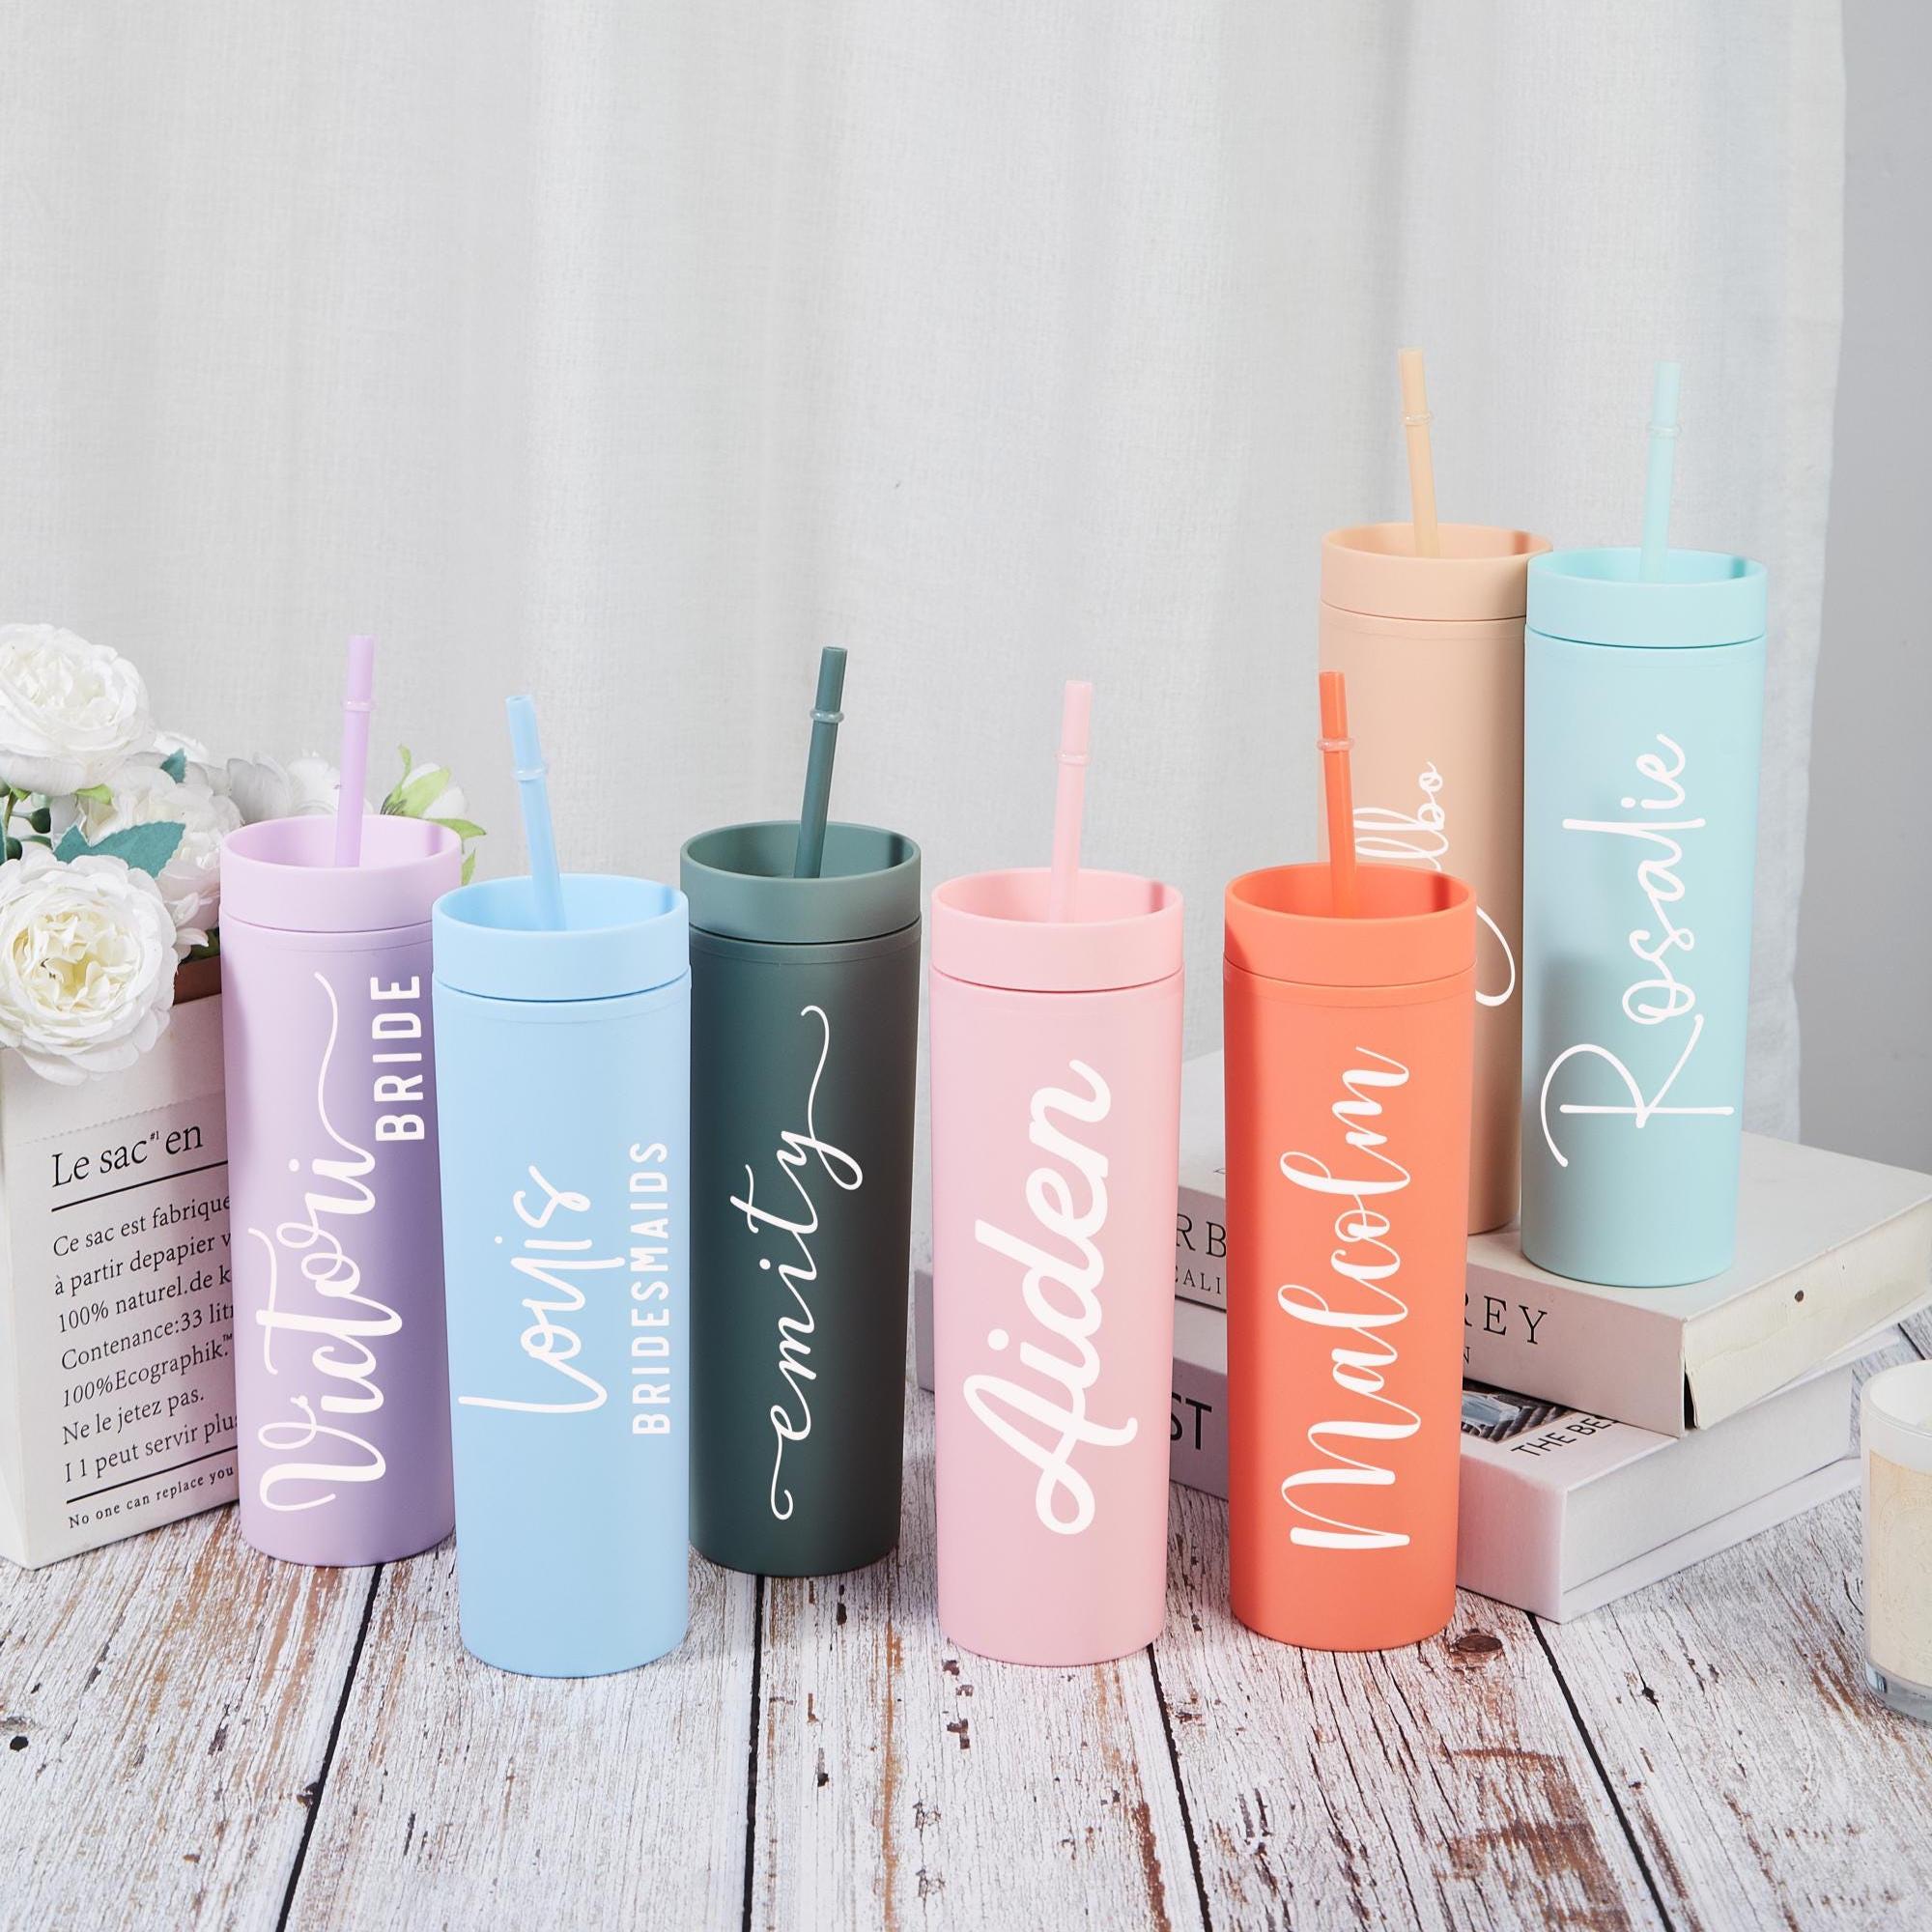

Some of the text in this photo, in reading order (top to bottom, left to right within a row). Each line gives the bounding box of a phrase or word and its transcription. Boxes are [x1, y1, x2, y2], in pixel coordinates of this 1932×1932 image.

[1540, 733, 1735, 1167] Rosalie
[371, 976, 425, 1141] BRIDE
[51, 1151, 90, 1188] Le
[165, 1124, 203, 1155] en
[53, 1236, 79, 1257] Ce
[85, 1227, 115, 1248] sac
[121, 1215, 147, 1237] est
[55, 1274, 66, 1295] à
[70, 1259, 124, 1296] partir
[129, 1236, 215, 1272] depapier
[729, 1005, 864, 1520] emity
[629, 1143, 670, 1435] BRIDESMAIDS
[963, 1059, 1138, 1535] Aiden
[1175, 1264, 1222, 1295] ALI
[1277, 1046, 1421, 1549] Malcolm
[58, 1300, 109, 1333] 100%
[62, 1388, 205, 1445] Ne le jetez pas.
[1510, 1414, 1620, 1457] THE BE
[96, 1443, 141, 1478] peut
[145, 1424, 198, 1457] servir
[69, 1466, 234, 1529] No one can replace you
